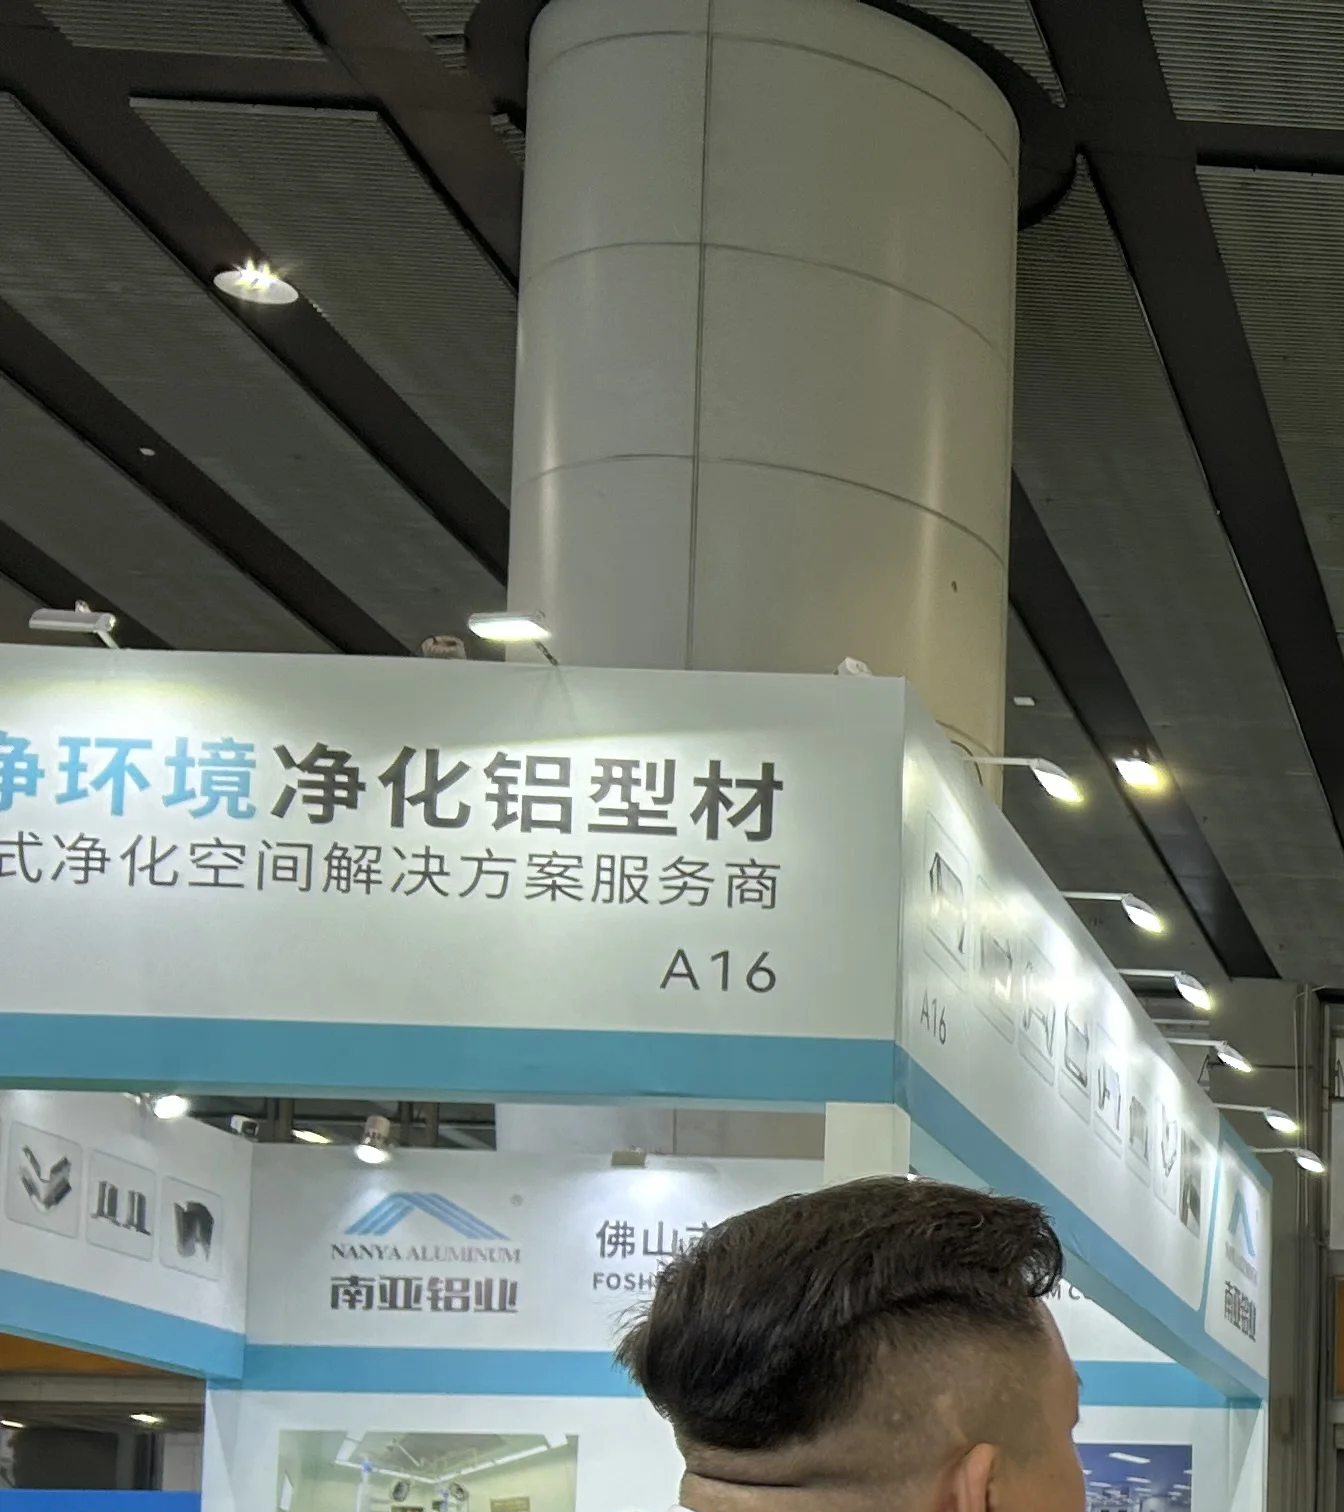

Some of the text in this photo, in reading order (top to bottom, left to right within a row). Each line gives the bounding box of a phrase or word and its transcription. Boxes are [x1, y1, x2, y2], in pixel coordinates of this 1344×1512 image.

[0, 830, 780, 911] 式净化空间解决方案服务商
[660, 949, 777, 993] A16
[920, 986, 947, 1046] A16
[331, 1243, 521, 1264] NANYA ALUMINUM
[330, 1274, 519, 1314] 南亚铝业
